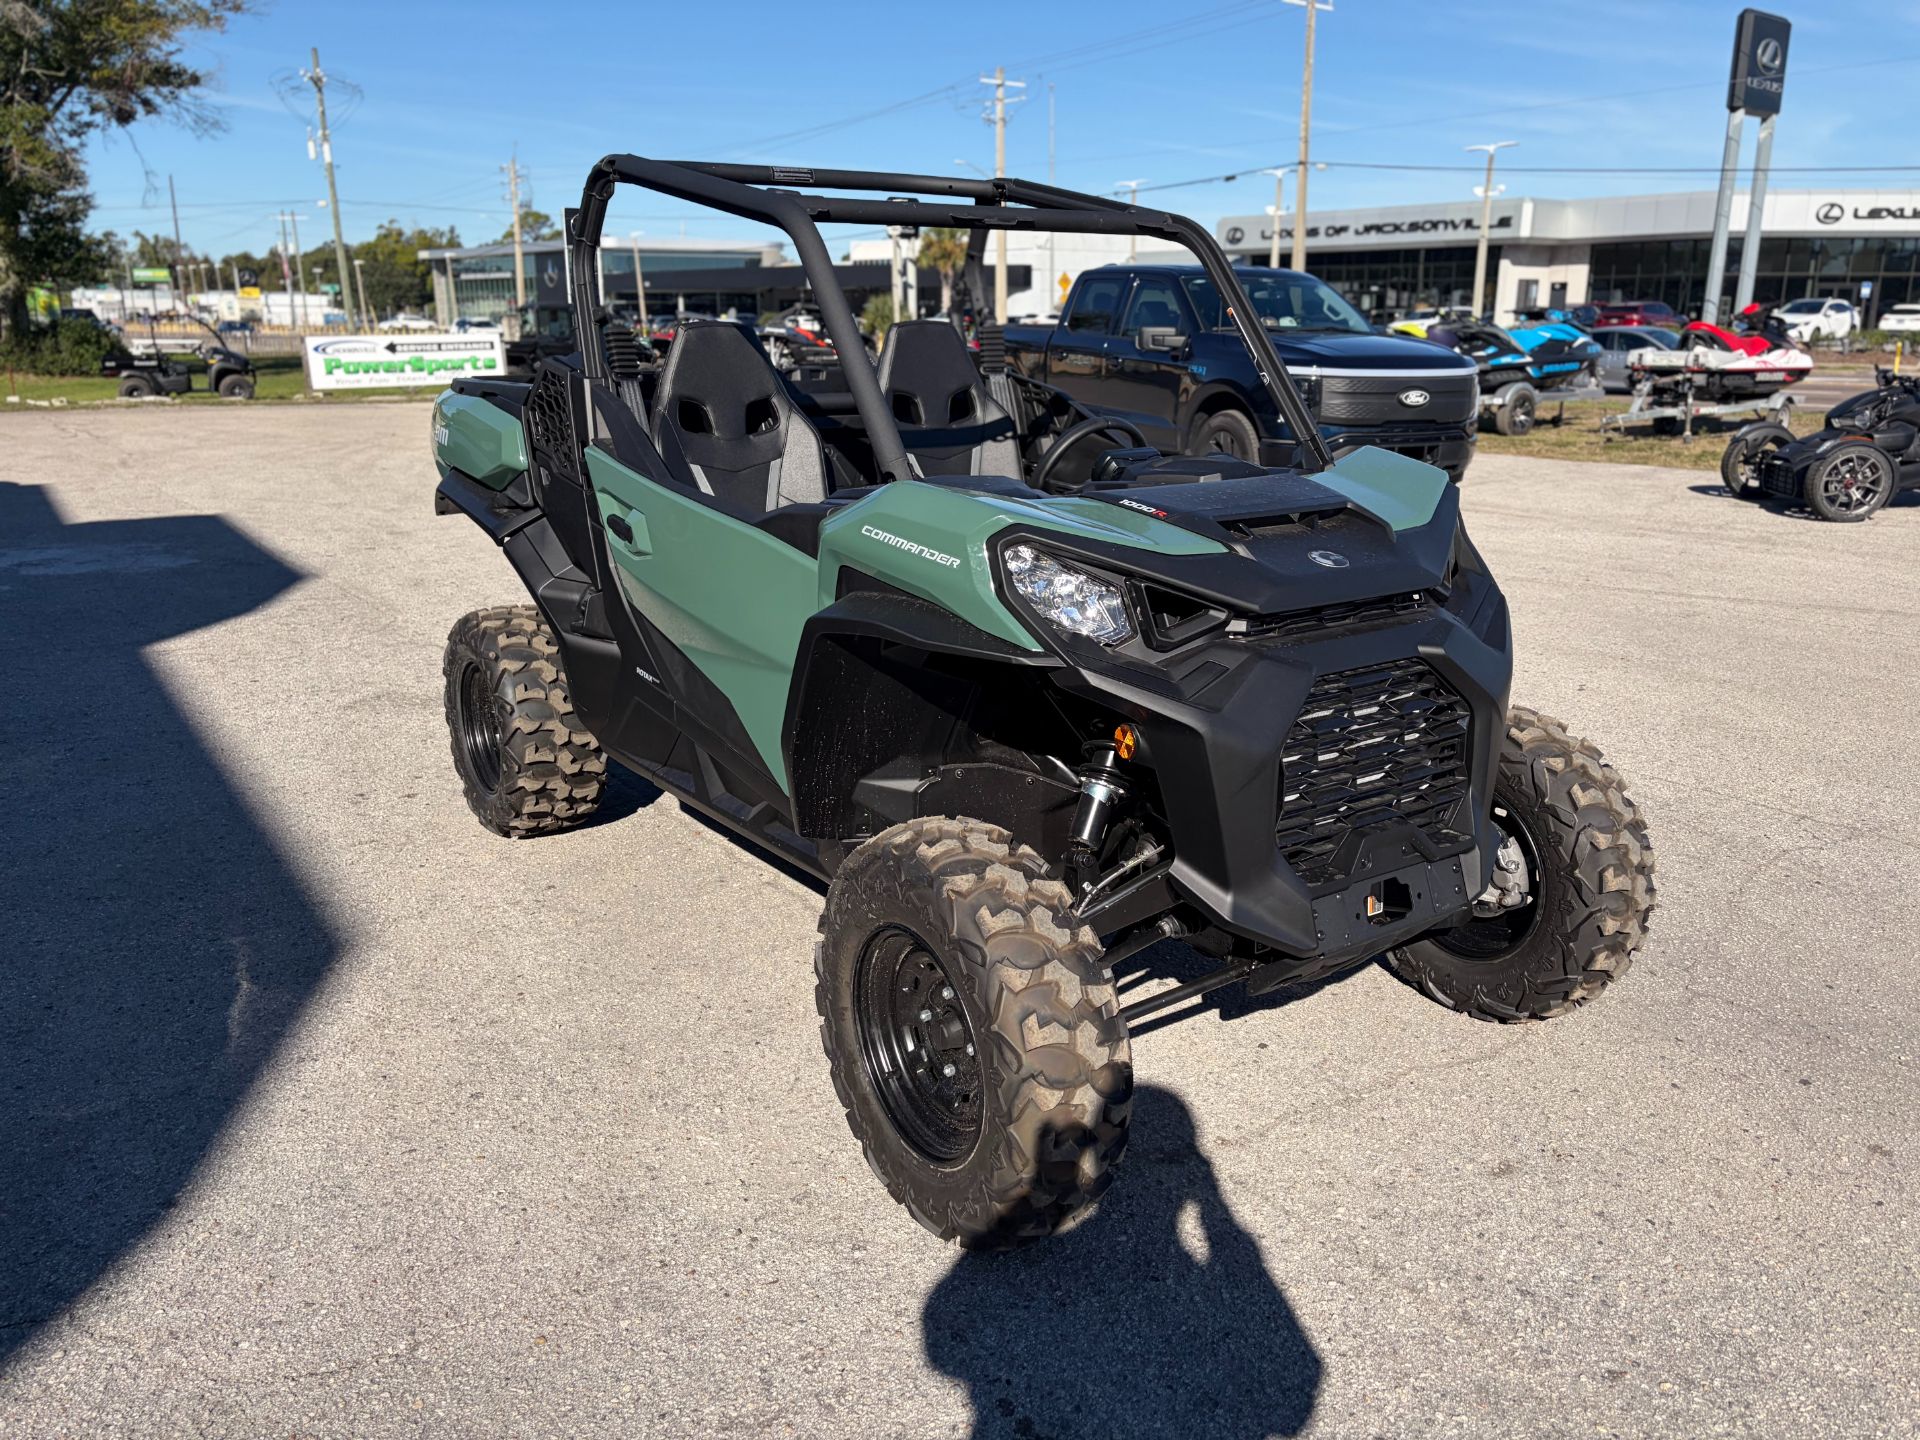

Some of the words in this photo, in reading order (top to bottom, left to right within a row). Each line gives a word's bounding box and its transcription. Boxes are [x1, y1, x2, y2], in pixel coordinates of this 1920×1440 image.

[1746, 76, 1783, 93] LEXUS
[1853, 207, 1920, 220] LEXU
[1261, 226, 1319, 240] LXS
[1325, 225, 1349, 238] OF
[323, 355, 497, 375] PowerSports
[1119, 499, 1168, 518] 1000R
[861, 525, 961, 569] COMMANDER
